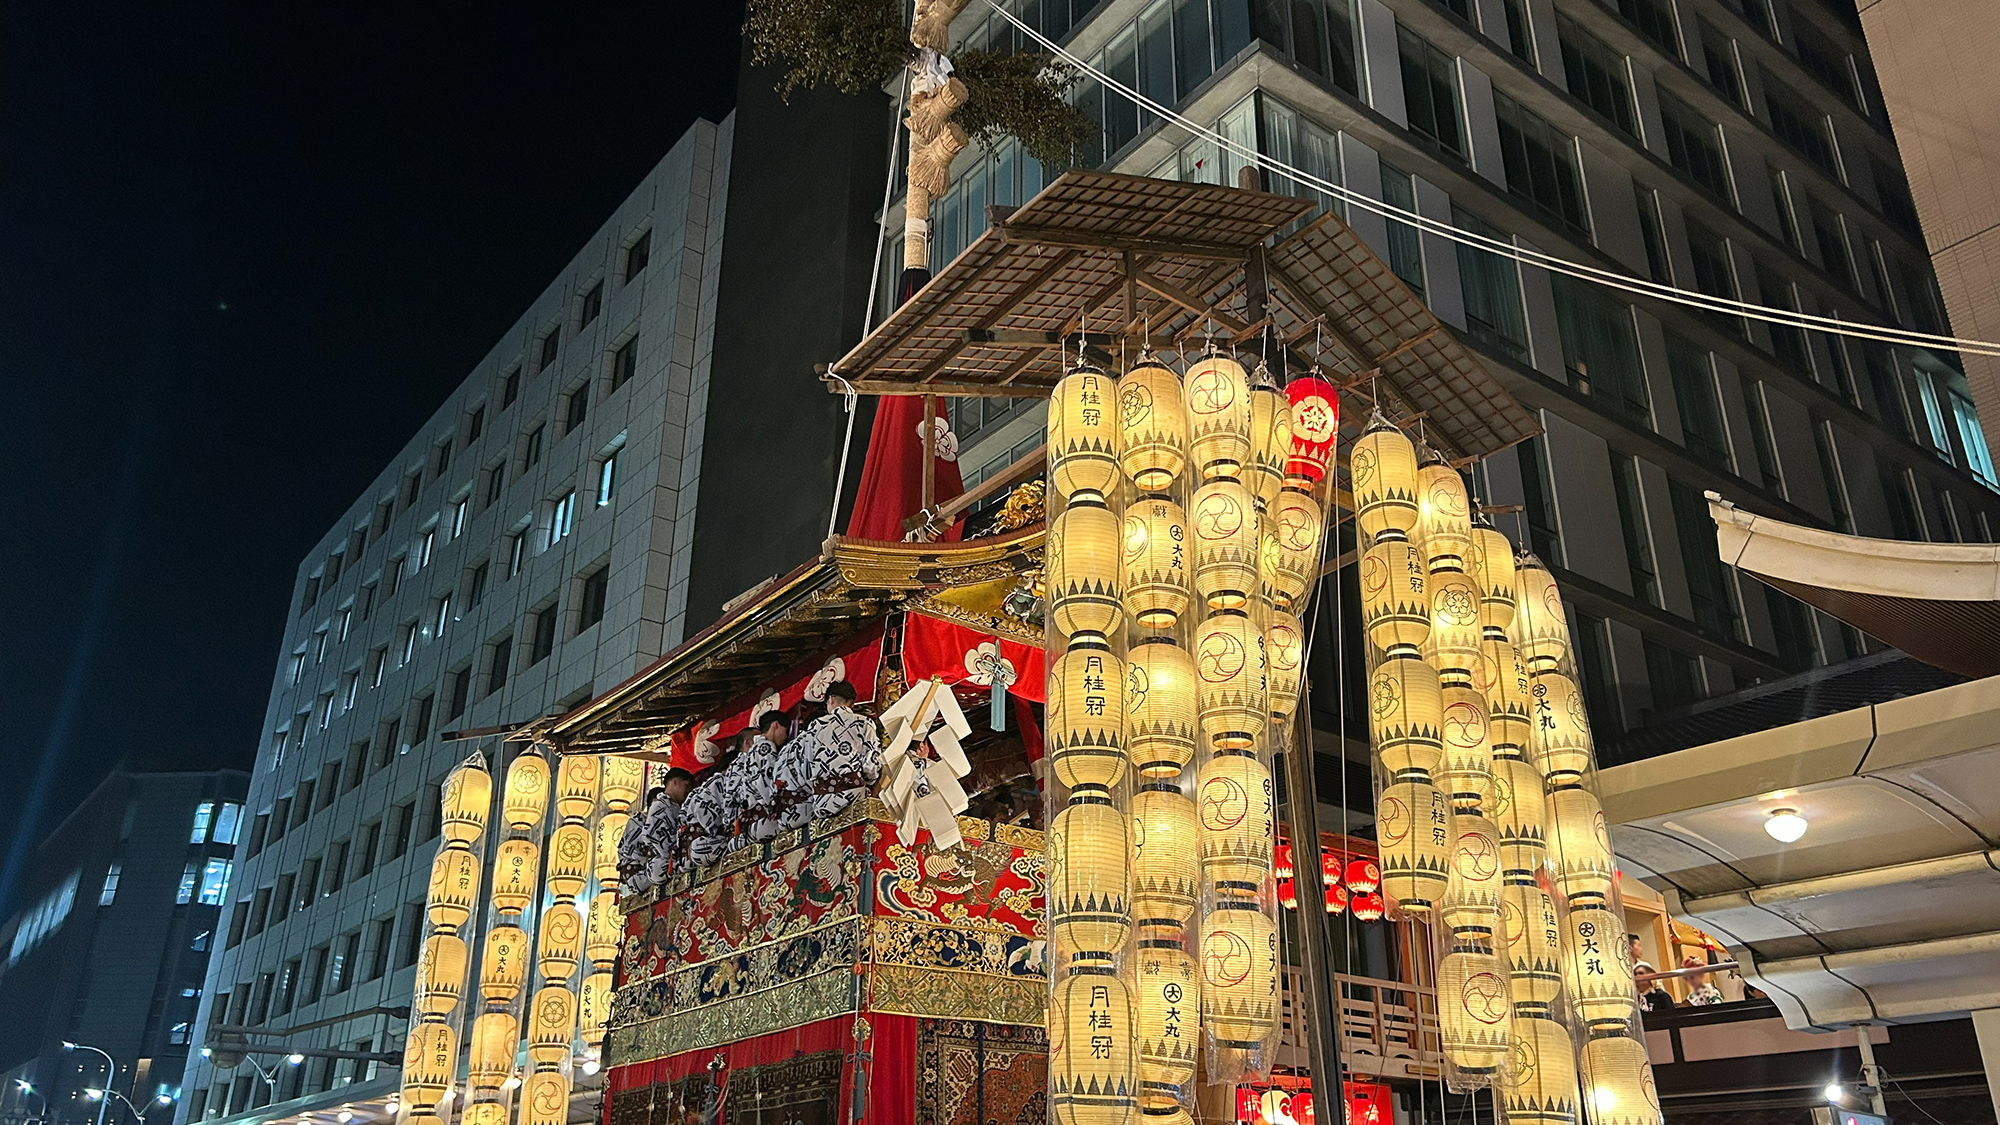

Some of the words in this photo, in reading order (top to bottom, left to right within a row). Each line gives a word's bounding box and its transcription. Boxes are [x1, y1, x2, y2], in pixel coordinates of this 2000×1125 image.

[1081, 376, 1101, 426] 月桂冠
[1171, 544, 1183, 570] 大丸
[1407, 546, 1424, 594] 月桂冠
[1083, 656, 1106, 716] 月桂冠
[1512, 647, 1528, 695] 月桂冠
[1535, 698, 1556, 732] 大丸
[1431, 791, 1446, 847] 月桂冠
[458, 855, 471, 890] 月桂冠
[1540, 893, 1558, 948] 月桂冠
[1581, 939, 1604, 976] 大丸
[1088, 985, 1113, 1060] 月桂冠
[1164, 1007, 1181, 1038] 大丸
[435, 1029, 448, 1067] 月桂冠
